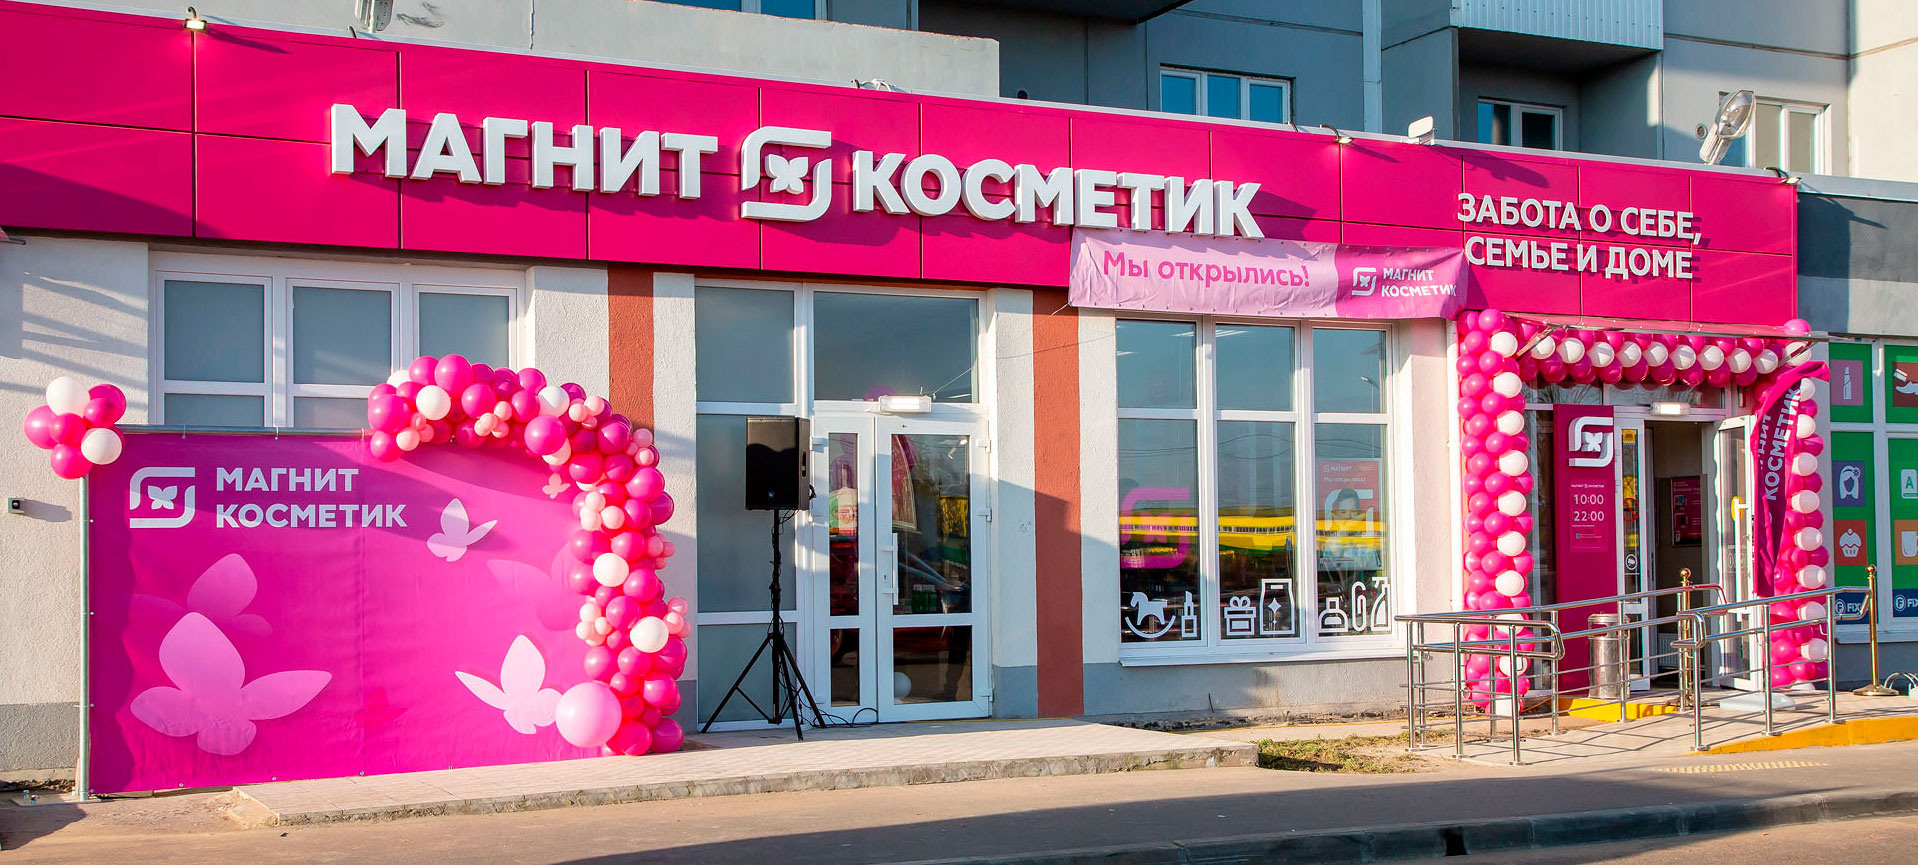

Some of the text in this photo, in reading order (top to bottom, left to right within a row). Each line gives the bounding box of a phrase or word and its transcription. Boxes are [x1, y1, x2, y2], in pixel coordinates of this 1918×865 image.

[331, 103, 1265, 239] МАГНИТ КОСМЕТИК
[1457, 192, 1702, 245] ЗАБОТА О СЕБЕ,
[1103, 250, 1310, 288] Мы открылись!
[1464, 236, 1693, 280] СЕМЬЕ И ДОМЕ
[1383, 267, 1434, 281] МАГНИТ
[1381, 284, 1457, 297] КОСМЕТИК
[1764, 387, 1801, 501] КОСМЕТИК
[216, 467, 359, 492] МАГНИТ
[1573, 494, 1604, 505] 10:00
[216, 503, 408, 528] КОСМЕТИК
[1573, 510, 1605, 522] 22:00
